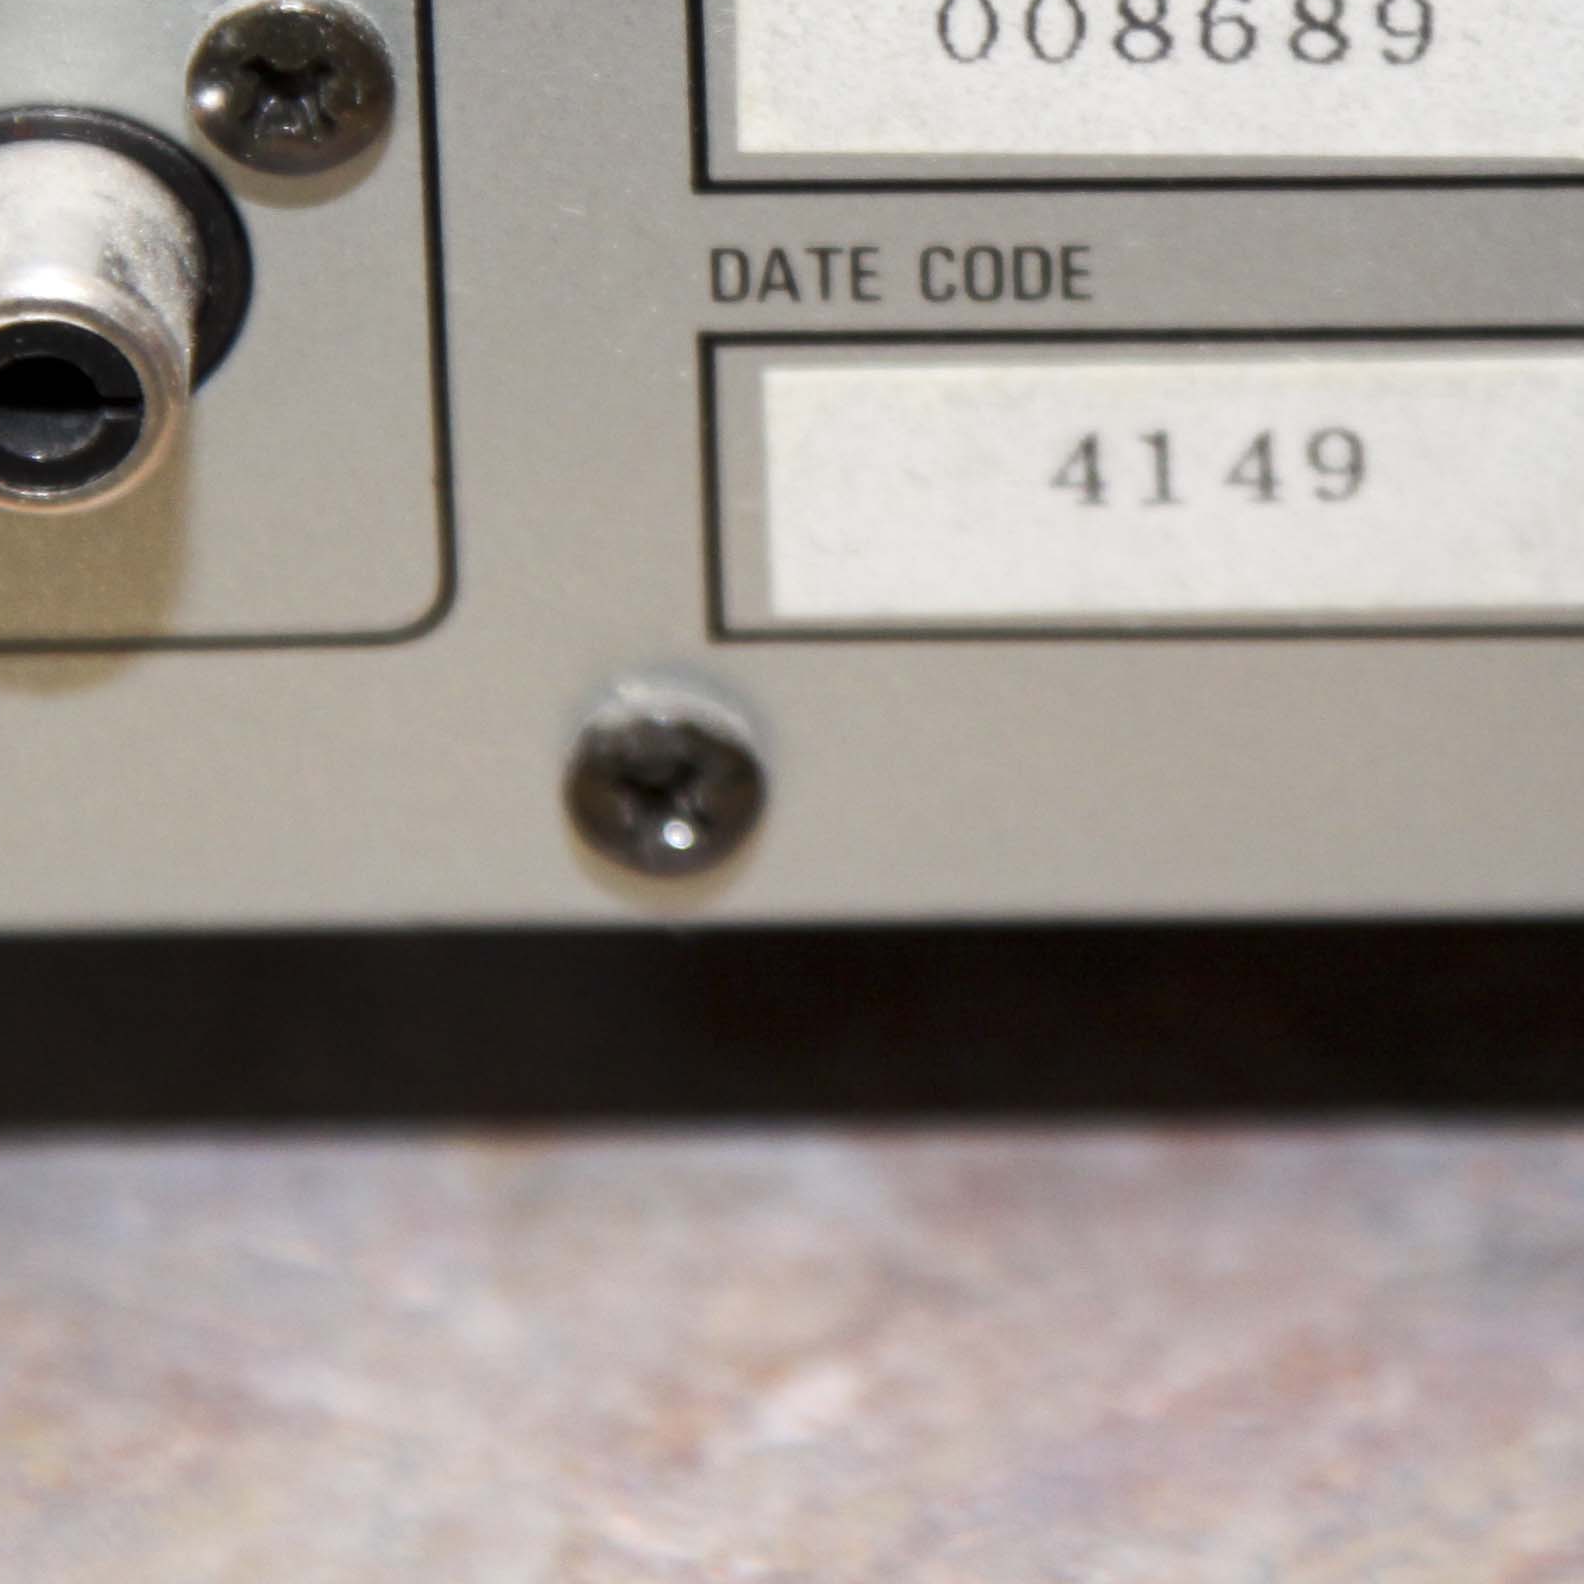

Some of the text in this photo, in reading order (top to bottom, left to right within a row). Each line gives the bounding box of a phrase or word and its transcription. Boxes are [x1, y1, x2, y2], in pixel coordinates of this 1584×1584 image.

[709, 243, 1093, 305] DATE CODE
[1049, 427, 1368, 507] 4149
